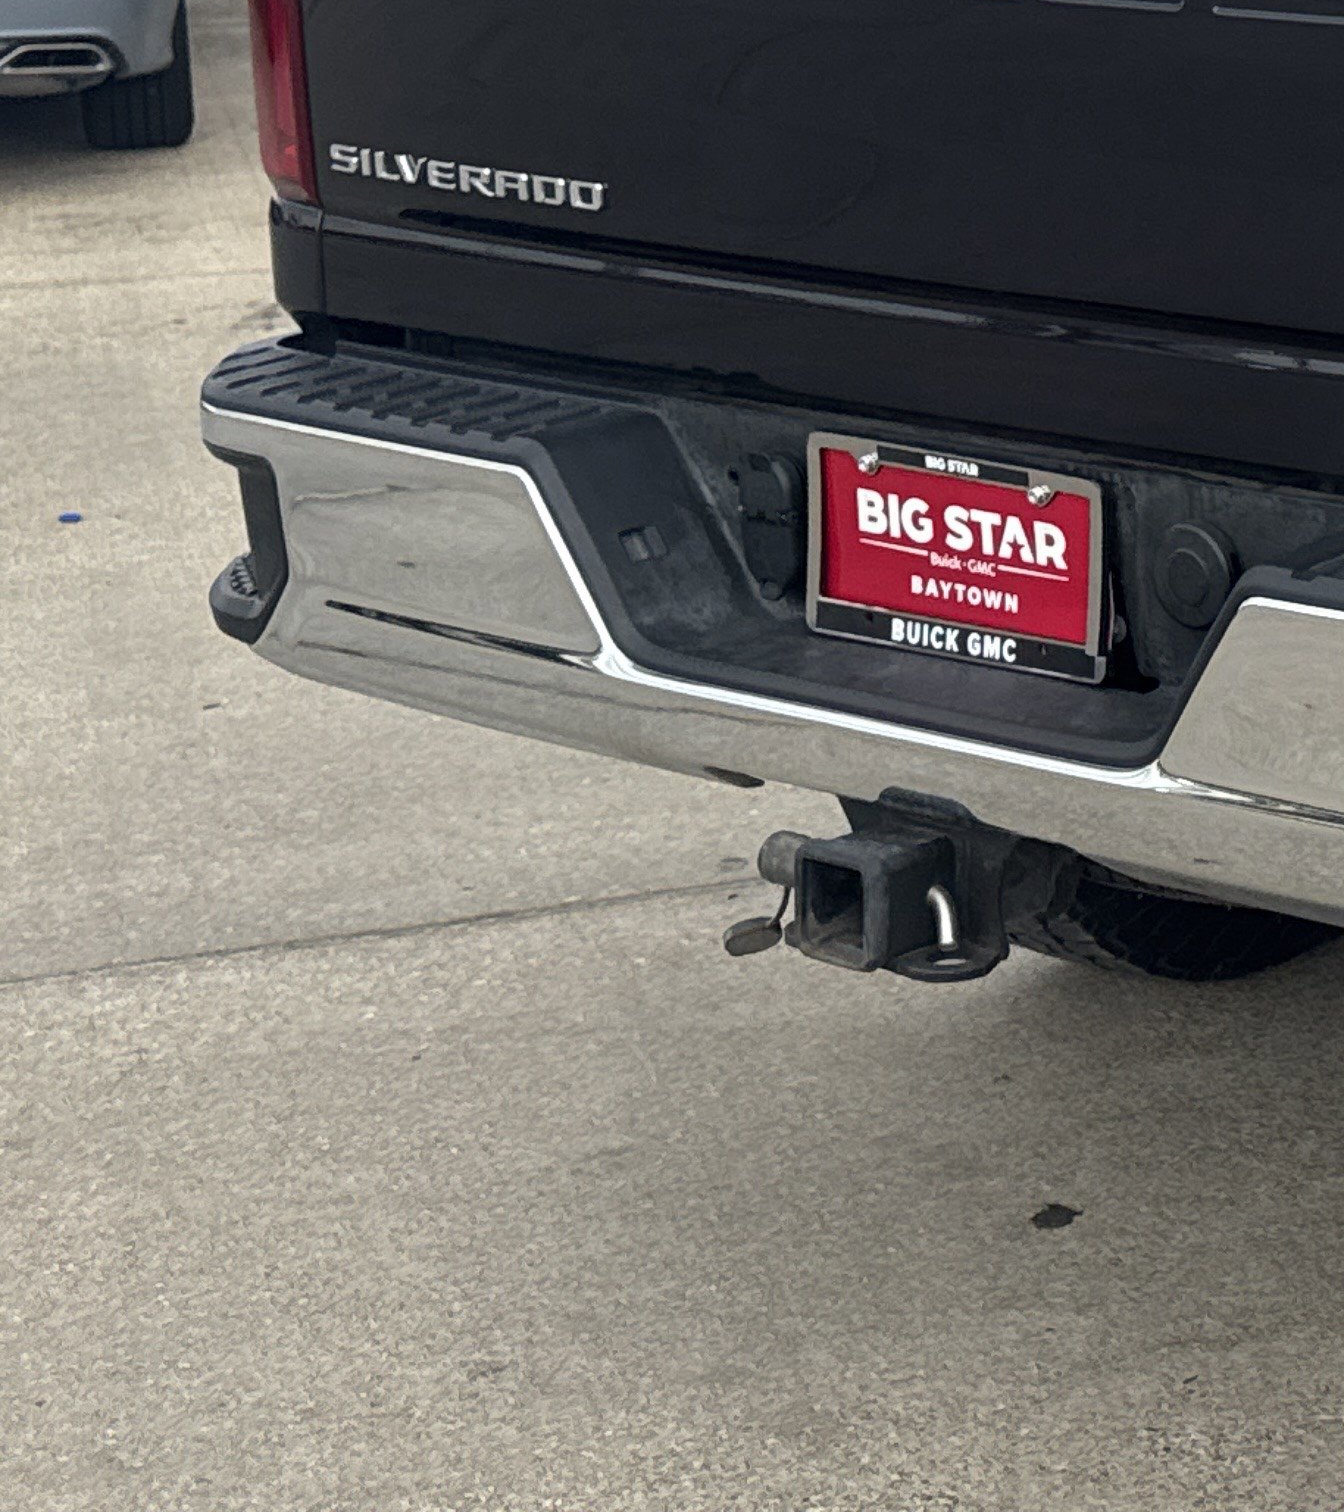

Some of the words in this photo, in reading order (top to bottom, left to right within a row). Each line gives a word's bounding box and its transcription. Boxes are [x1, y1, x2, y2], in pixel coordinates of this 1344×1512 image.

[329, 143, 607, 212] SILVERADO
[924, 454, 946, 471] BIG
[947, 459, 979, 477] STAR
[856, 487, 934, 544] BIG
[943, 504, 1068, 570] STAR
[910, 575, 1019, 614] BAYTOWN
[891, 618, 959, 653] BUICK
[966, 632, 1018, 663] GMC
